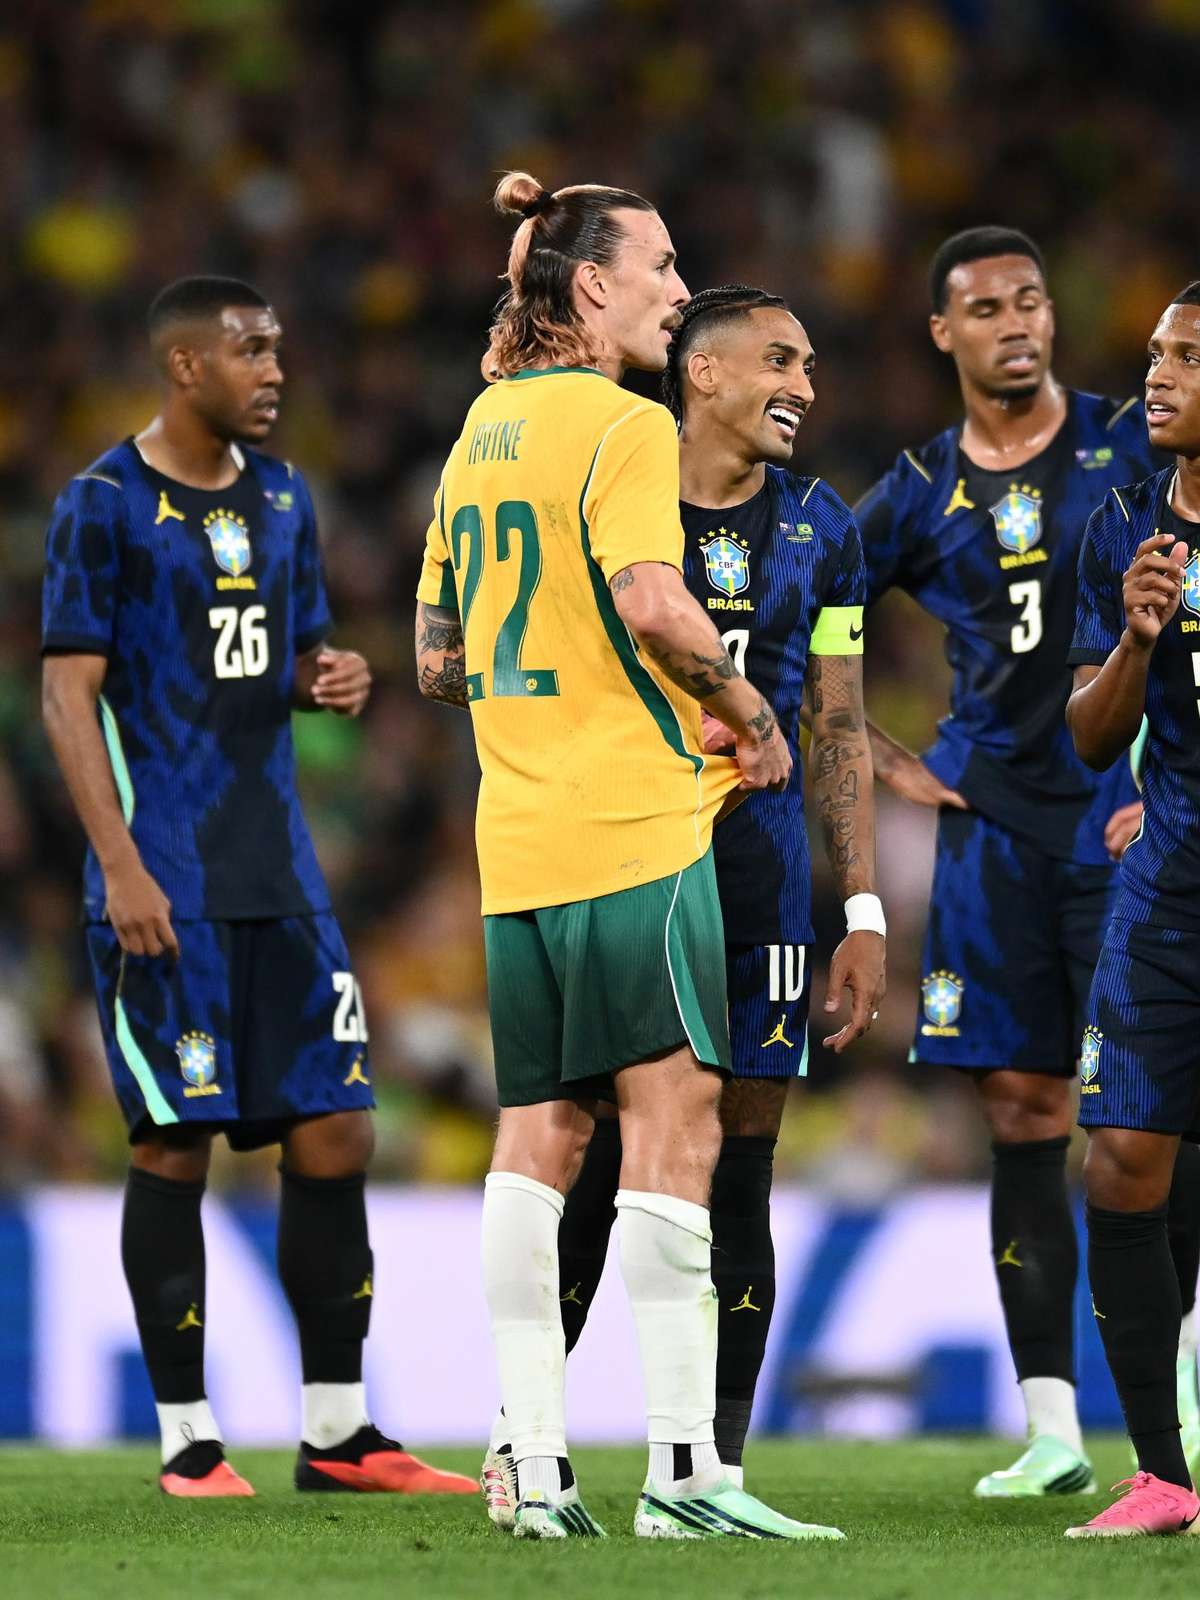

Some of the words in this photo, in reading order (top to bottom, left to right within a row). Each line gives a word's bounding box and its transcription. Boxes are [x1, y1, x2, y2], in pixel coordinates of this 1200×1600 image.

[468, 418, 527, 465] IRVINE
[718, 561, 735, 569] CBF
[451, 500, 560, 701] 22
[707, 598, 755, 611] BRASIL
[1009, 579, 1043, 654] 3
[208, 605, 270, 679] 26
[1181, 620, 1200, 632] BR
